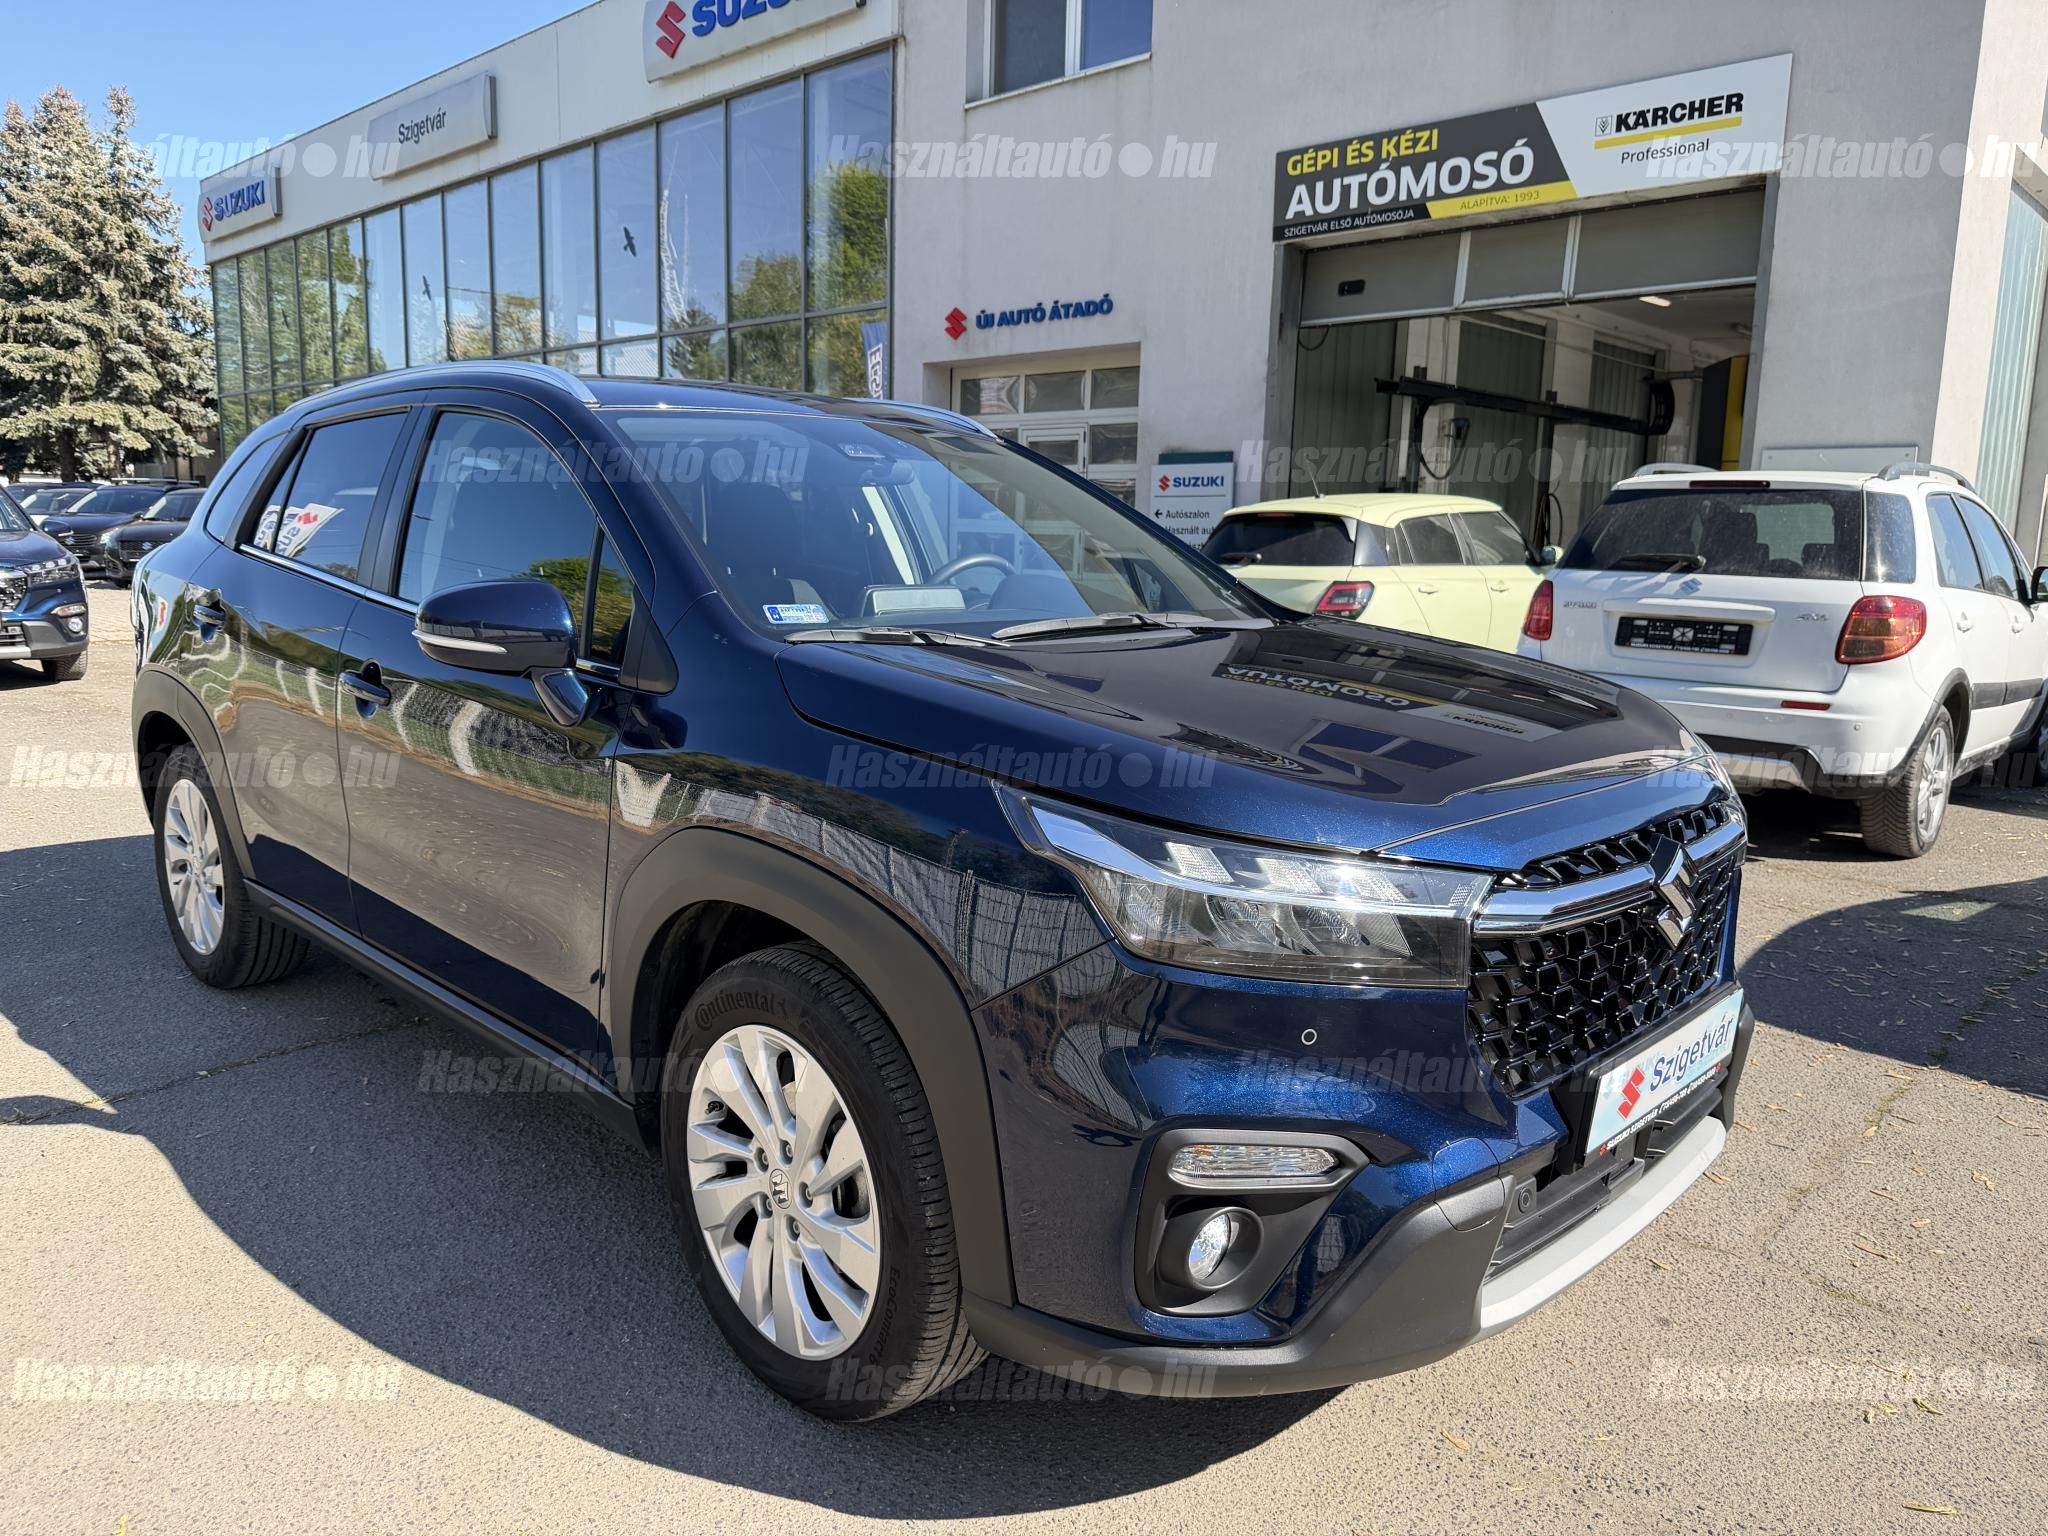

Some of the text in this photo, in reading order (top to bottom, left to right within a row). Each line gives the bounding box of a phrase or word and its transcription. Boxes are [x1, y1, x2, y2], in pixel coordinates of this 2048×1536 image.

[692, 0, 797, 37] SUZ
[398, 108, 447, 144] Szigetvár
[1615, 92, 1744, 133] KÄRCHER
[1287, 128, 1439, 176] GÉPI ÉS KÉZI
[1621, 138, 1710, 165] Professional
[1285, 137, 1534, 220] AUTÓMOSÓ
[213, 180, 266, 222] SUZUKI
[1460, 190, 1541, 211] ALAPÍTVA: 1993
[1284, 221, 1328, 238] SZIGETVÁR
[1353, 208, 1415, 227] AUTÓMOSÓJA
[976, 294, 1114, 329] ÚJ AUTÓ ÁTADÓ
[1173, 475, 1224, 488] SUZUKI
[1166, 510, 1210, 519] Autószalon
[695, 990, 776, 1031] Continental
[1650, 1012, 1734, 1092] Szigetvár
[873, 1265, 900, 1357] EcoContact
